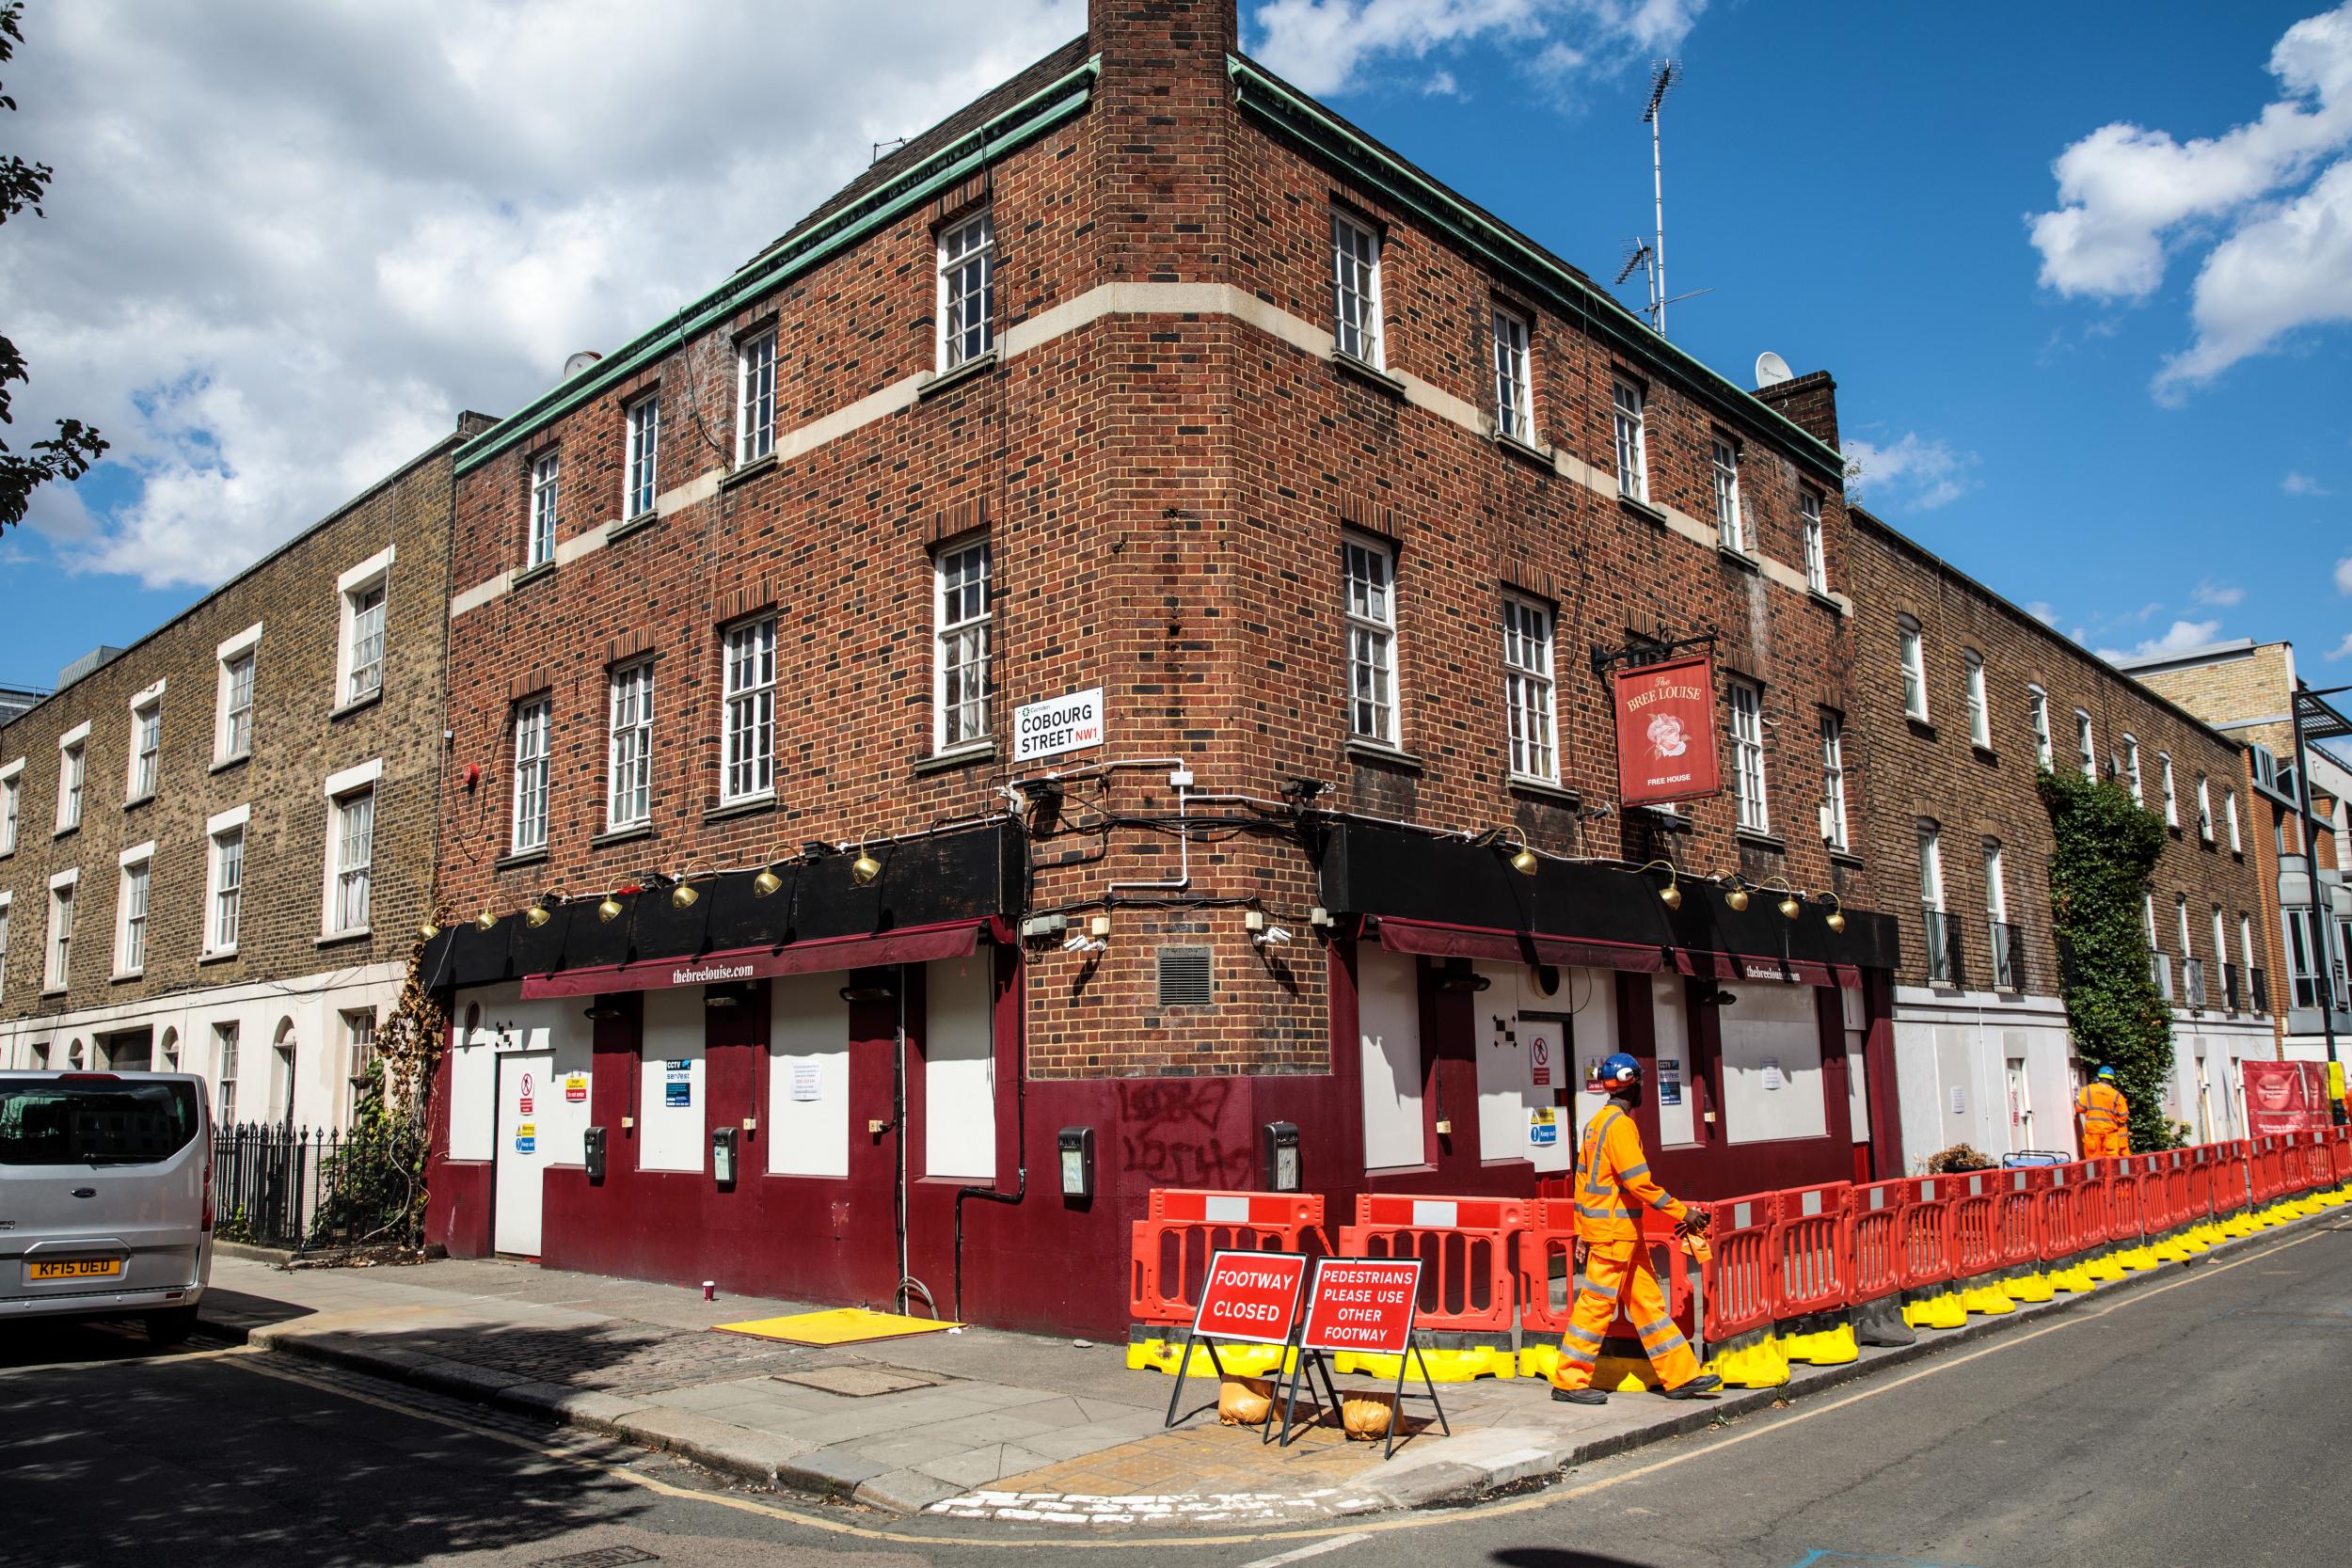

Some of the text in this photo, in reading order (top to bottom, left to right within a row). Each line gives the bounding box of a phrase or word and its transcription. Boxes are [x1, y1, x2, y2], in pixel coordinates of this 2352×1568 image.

[1655, 676, 1671, 687] The
[1626, 686, 1702, 712] BREE LOUISE
[1030, 705, 1051, 713] Camden
[1022, 705, 1092, 734] COBOURG
[1022, 727, 1097, 752] STREET NW1
[1647, 773, 1691, 785] FREE HOUSE
[673, 964, 754, 983] thebreelouise.com
[40, 1261, 75, 1275] KF15
[1216, 1271, 1295, 1291] FOOTWAY
[1323, 1271, 1413, 1285] PEDESTRIANS
[1324, 1289, 1405, 1303] PLEASE USE
[1214, 1301, 1280, 1322] CLOSED
[1338, 1308, 1382, 1322] OTHER
[1325, 1326, 1388, 1341] FOOTWAY
